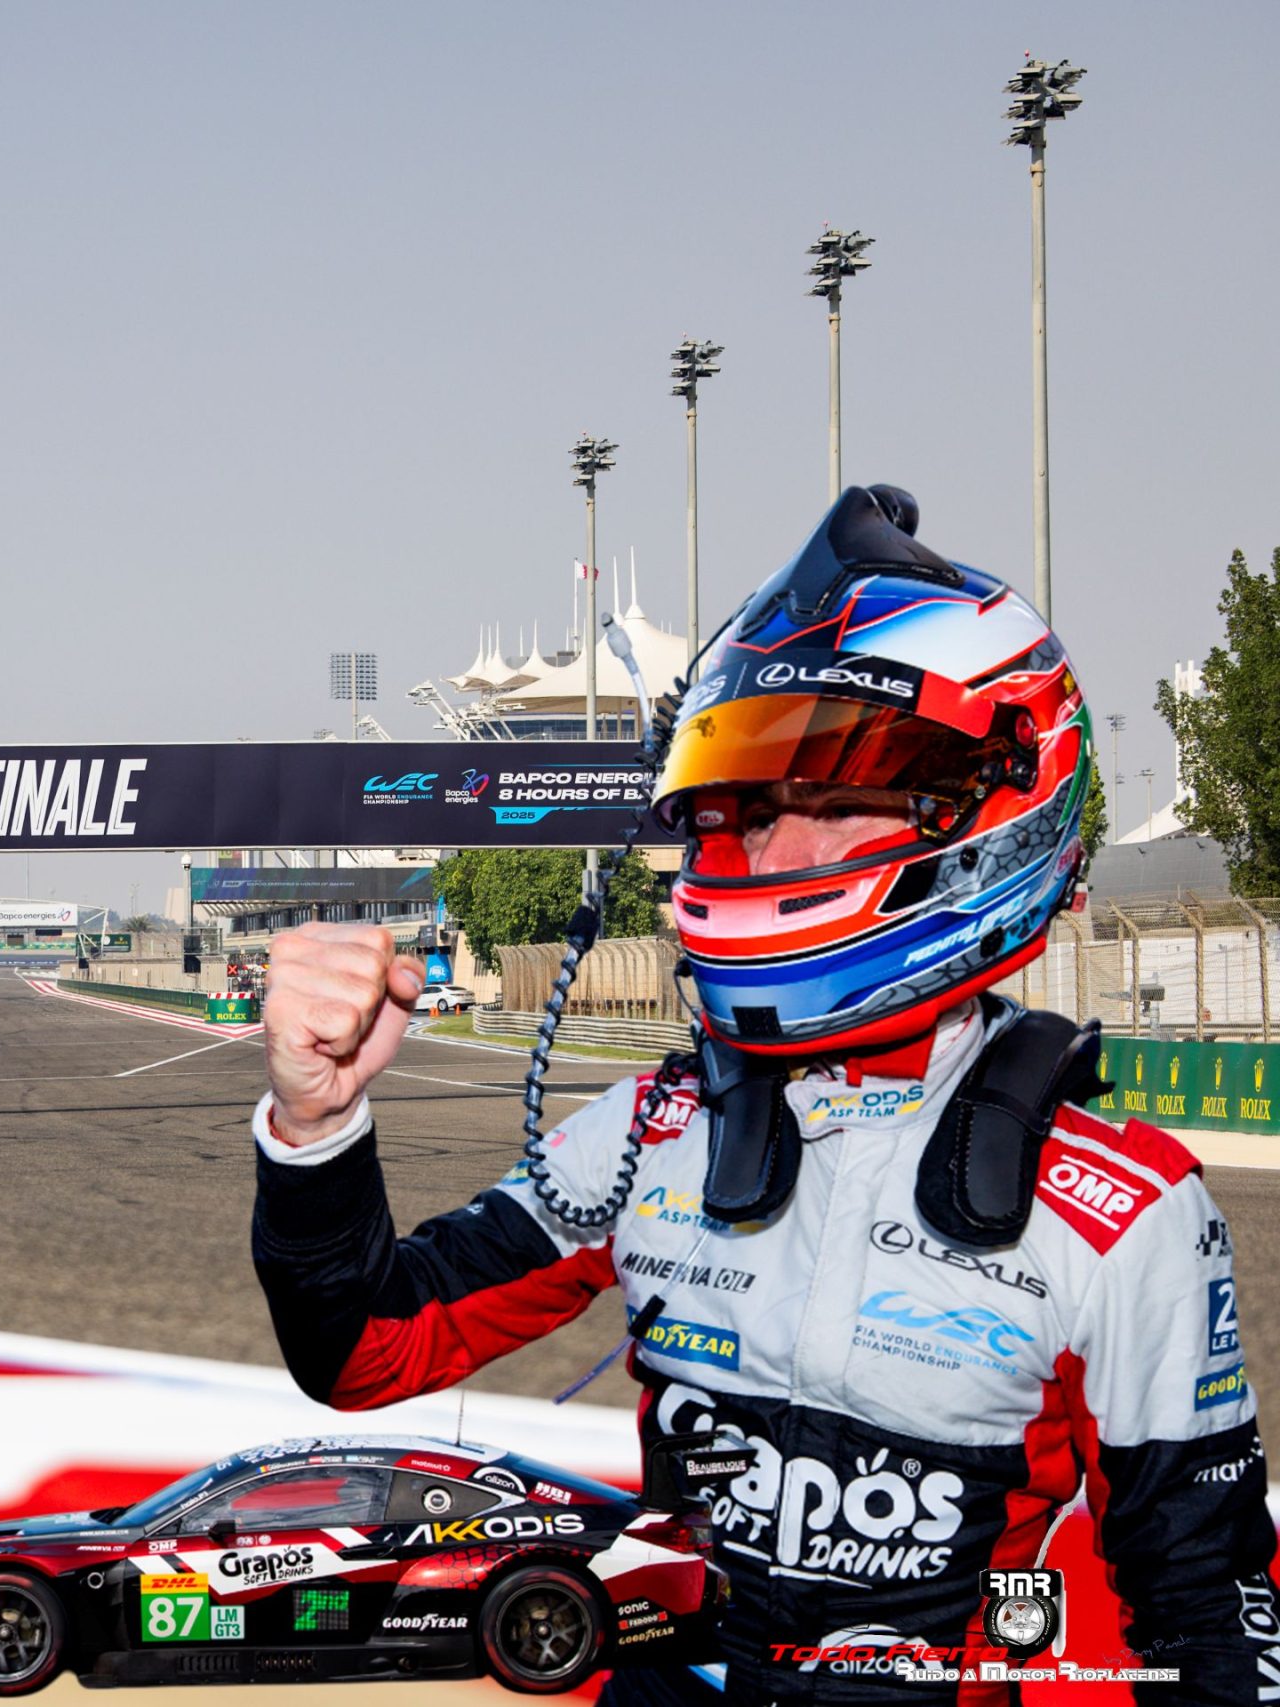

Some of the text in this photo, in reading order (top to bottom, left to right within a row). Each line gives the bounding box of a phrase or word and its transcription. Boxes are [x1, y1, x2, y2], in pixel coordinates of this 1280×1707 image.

[798, 666, 915, 698] LEXUS
[363, 772, 440, 791] WEC
[498, 772, 650, 784] BAPCO ENERG
[444, 789, 471, 799] Bapco
[444, 796, 479, 805] energies
[498, 788, 514, 801] 8
[516, 788, 589, 801] HOURS
[592, 788, 621, 801] OF
[501, 811, 536, 820] 2025
[22, 911, 57, 921] energies
[216, 1012, 247, 1021] ROLEX
[828, 1106, 896, 1118] ASP TEAM
[1156, 1094, 1186, 1116] ROLEX
[1201, 1096, 1228, 1119] ROLEX
[1240, 1097, 1271, 1121] ROLEX
[1047, 1160, 1137, 1219] OMP
[658, 1208, 691, 1225] ASP
[919, 1238, 1048, 1300] LEXUS
[714, 1267, 757, 1294] OIL
[851, 1335, 962, 1372] CHAMPIONSHIP
[854, 1324, 1019, 1377] FIA WORLD ENDURANCE
[402, 1513, 585, 1546] AKKODIS
[148, 1540, 177, 1552] OMP
[801, 1534, 953, 1580] DRINKS
[151, 1577, 199, 1589] DHL
[243, 1565, 313, 1586] SOFT DRINKS
[147, 1596, 204, 1638] 87
[217, 1608, 238, 1623] LM
[617, 1601, 650, 1616] SONIC
[214, 1623, 241, 1637] GT3
[382, 1611, 468, 1631] GOODYEAR
[617, 1626, 675, 1645] GOODYEAR
